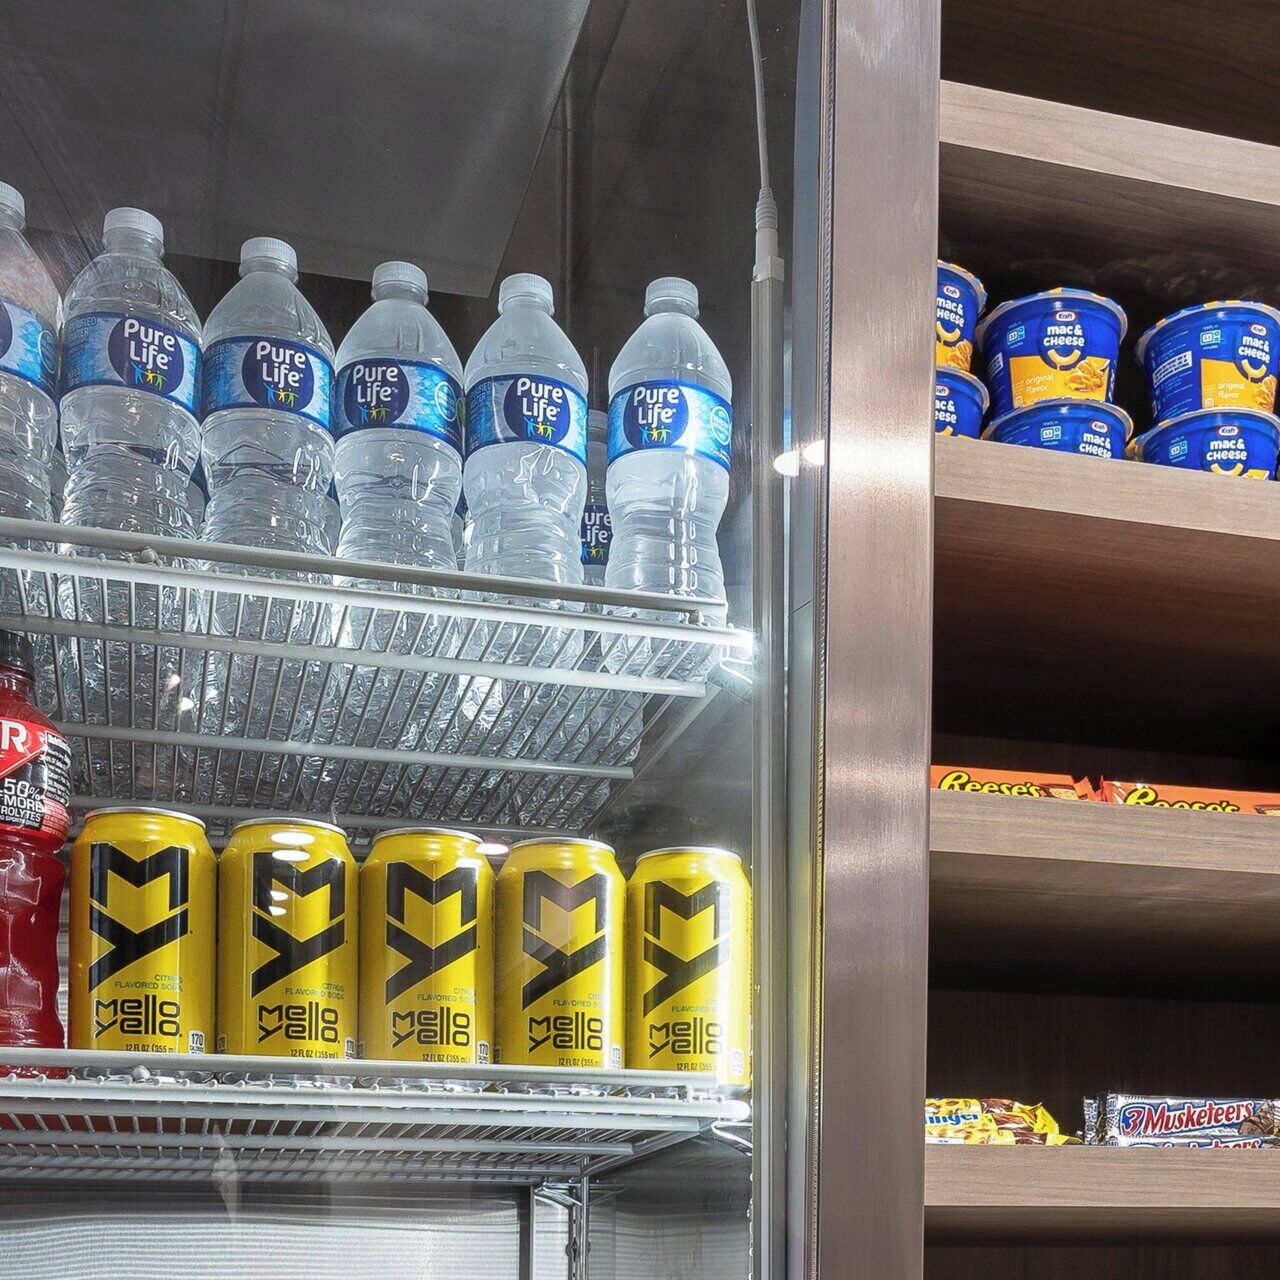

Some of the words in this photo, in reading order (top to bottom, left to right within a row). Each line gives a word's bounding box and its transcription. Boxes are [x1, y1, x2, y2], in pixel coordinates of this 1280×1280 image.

[1058, 312, 1074, 320] Kraft
[124, 319, 176, 352] Pure
[130, 343, 169, 370] Life
[256, 341, 306, 369] Pure
[262, 363, 300, 388] Life
[353, 364, 398, 385] Pure
[1025, 373, 1054, 385] original
[357, 383, 392, 406] Life
[517, 378, 563, 404] Pure
[634, 387, 679, 406] Pure
[1026, 384, 1048, 395] flavor
[522, 398, 558, 422] Life
[638, 403, 673, 427] Life
[1221, 426, 1237, 436] Kraft
[4, 778, 41, 801] 50%
[4, 796, 43, 812] MORE
[285, 988, 325, 997] FLAVORED
[327, 991, 345, 1000] SODA
[553, 999, 591, 1008] FLAVORED
[1122, 1106, 1142, 1135] 3
[1142, 1101, 1253, 1135] Musketeers
